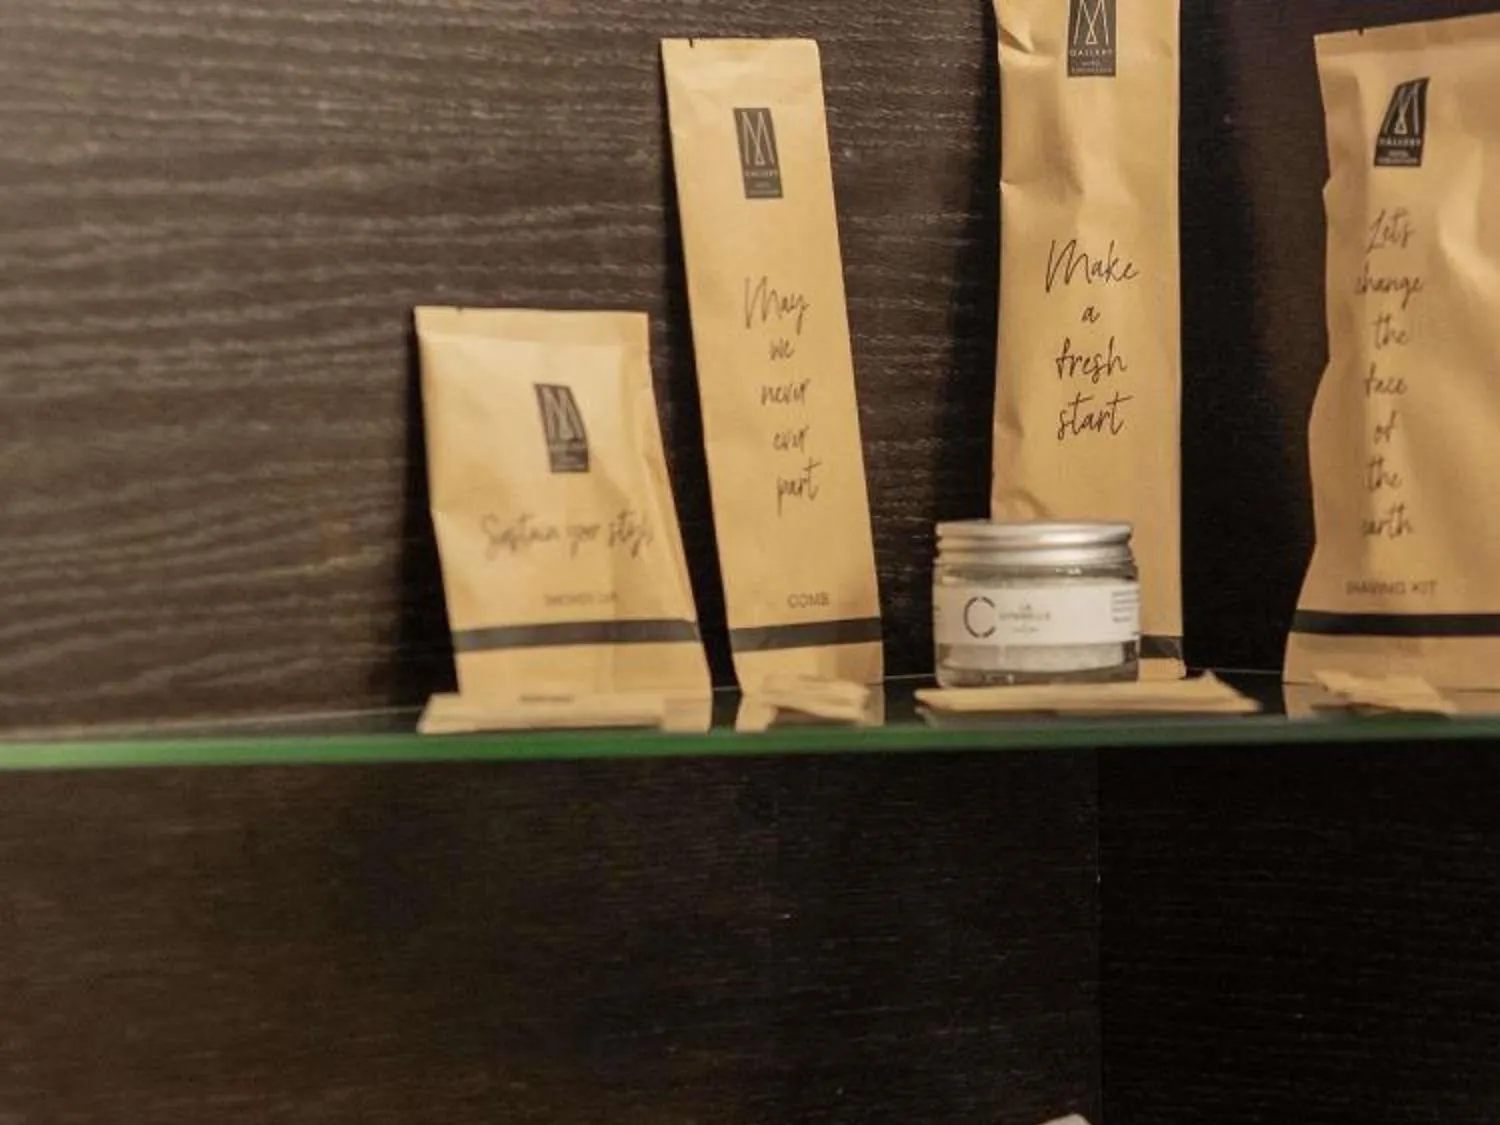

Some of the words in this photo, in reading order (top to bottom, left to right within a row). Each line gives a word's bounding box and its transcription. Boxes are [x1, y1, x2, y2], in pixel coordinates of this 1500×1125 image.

[1045, 239, 1139, 294] Make
[743, 275, 811, 337] May
[1081, 305, 1101, 324] a
[768, 336, 796, 361] we
[1369, 313, 1409, 350] the
[1055, 336, 1128, 386] fresh
[1364, 361, 1409, 397] face
[761, 377, 812, 406] never
[1057, 391, 1134, 441] start
[1373, 409, 1400, 445] of
[772, 425, 810, 453] ever
[776, 456, 823, 518] part
[1365, 455, 1404, 491] the
[786, 591, 831, 609] COMB
